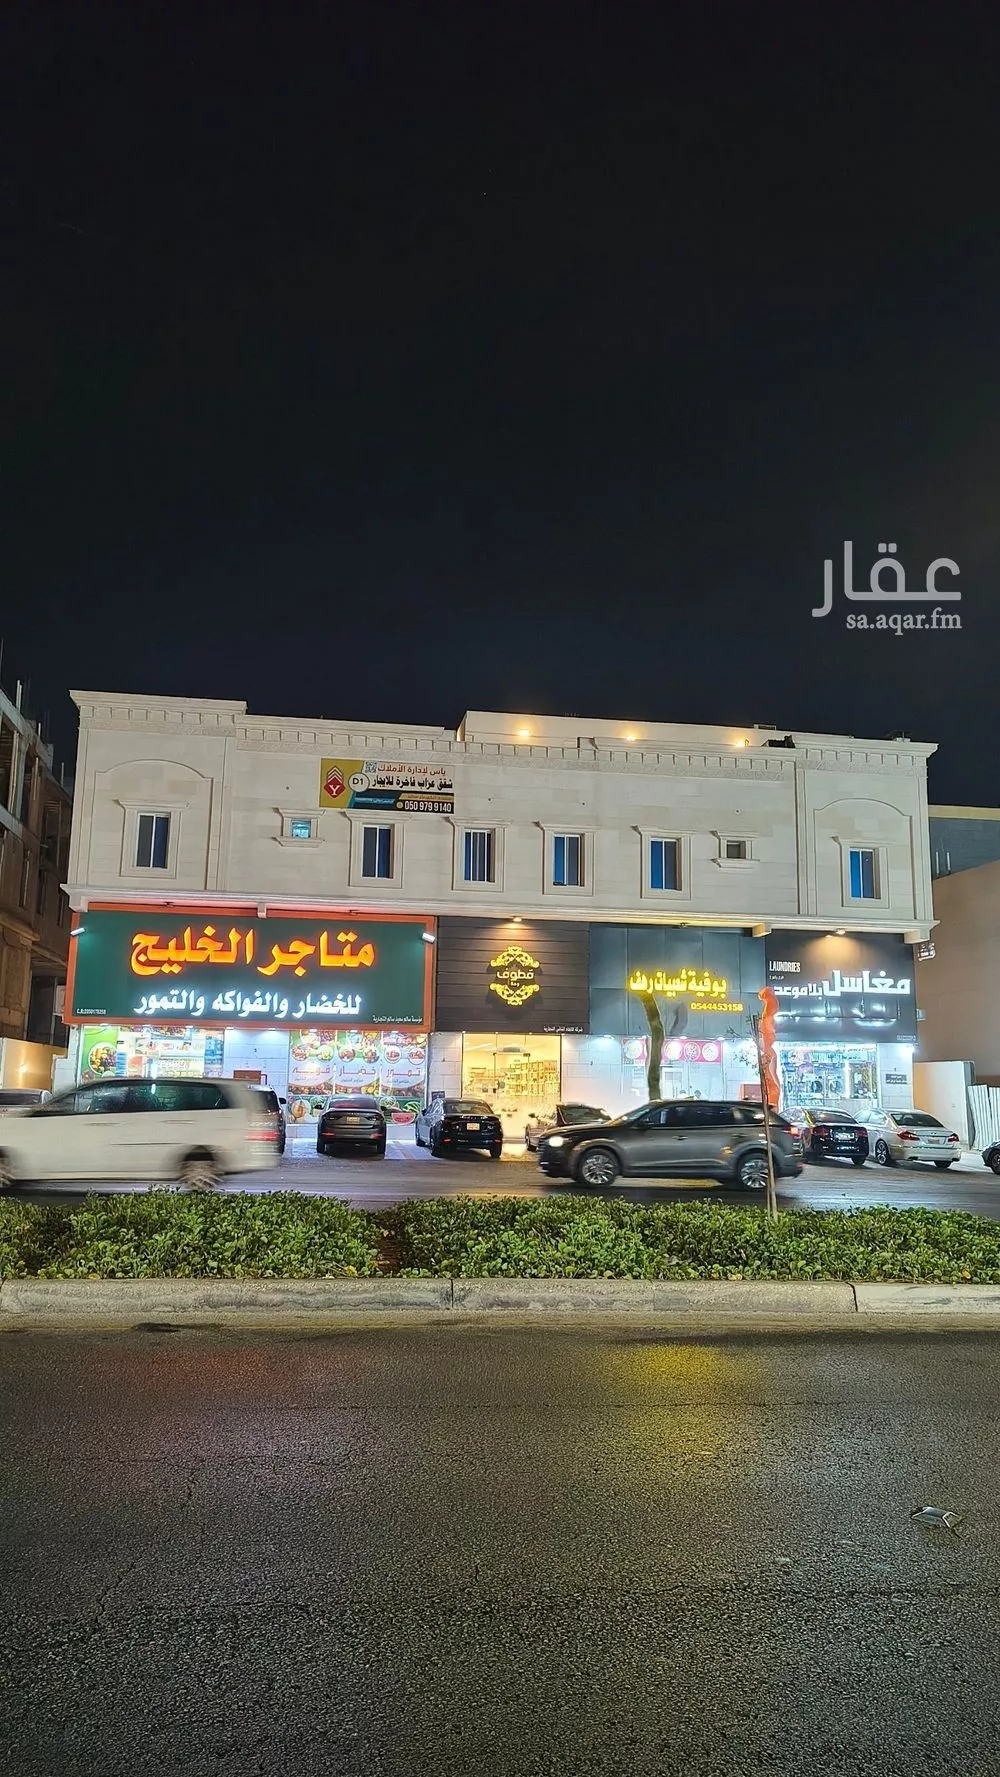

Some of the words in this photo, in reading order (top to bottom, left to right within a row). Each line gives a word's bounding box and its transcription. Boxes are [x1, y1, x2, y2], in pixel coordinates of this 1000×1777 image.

[352, 777, 364, 785] D1
[396, 776, 416, 789] فاخرة
[131, 925, 254, 976] الخليج
[257, 930, 375, 977] متاجر
[769, 960, 801, 973] LAUNDRIES
[822, 969, 911, 997] مغاسل
[133, 988, 205, 1017] والتمور
[212, 990, 289, 1018] والفواكه
[293, 993, 362, 1019] للخضار
